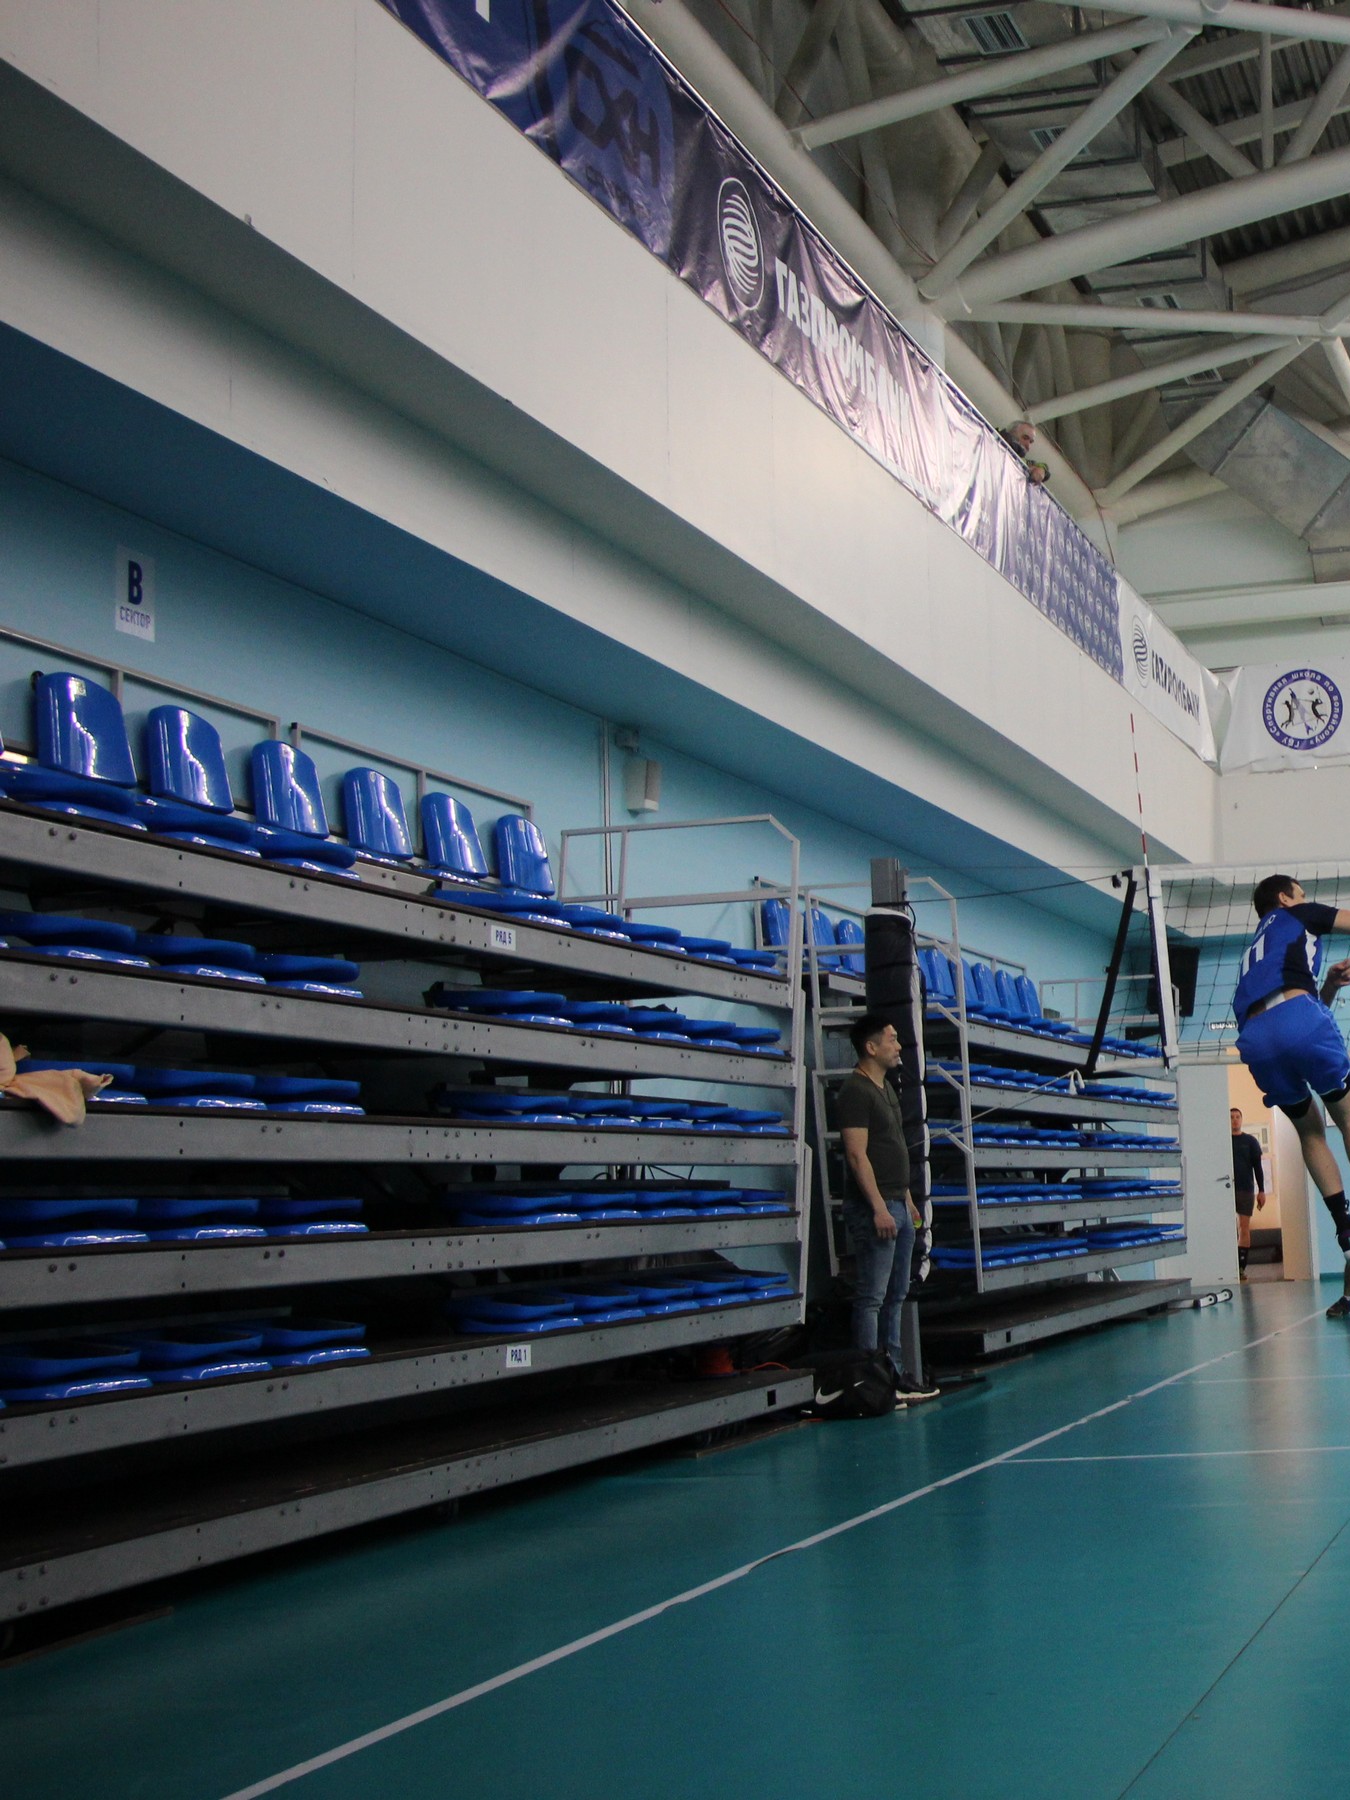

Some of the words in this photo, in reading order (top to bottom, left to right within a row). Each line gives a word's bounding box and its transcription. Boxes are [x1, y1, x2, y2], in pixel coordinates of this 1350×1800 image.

[120, 606, 151, 629] СЕКТОР
[1282, 736, 1300, 748] ГБУ
[1291, 671, 1322, 681] школа
[1323, 680, 1334, 692] по
[496, 930, 507, 945] РЯД
[1242, 934, 1265, 976] 11
[511, 1349, 522, 1363] РЯД
